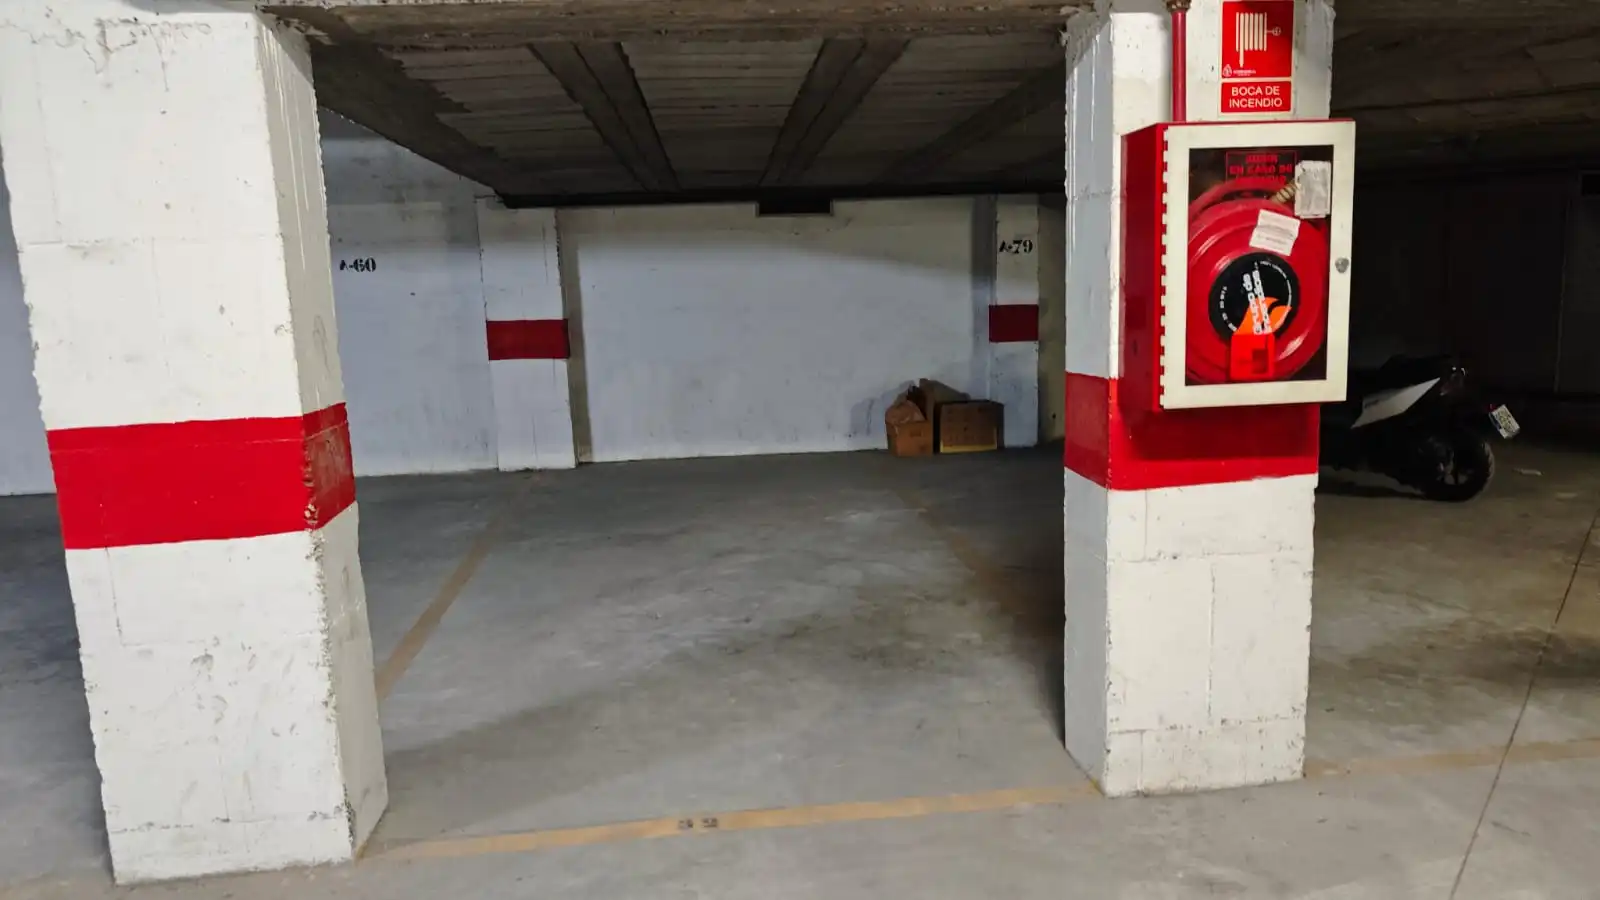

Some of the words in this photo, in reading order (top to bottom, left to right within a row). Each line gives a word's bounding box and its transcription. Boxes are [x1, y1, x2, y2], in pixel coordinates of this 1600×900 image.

[1231, 86, 1263, 97] BOCA
[1265, 85, 1280, 96] DE
[1229, 97, 1283, 108] INCENDIO
[999, 239, 1033, 254] A-79
[339, 257, 377, 272] A-60
